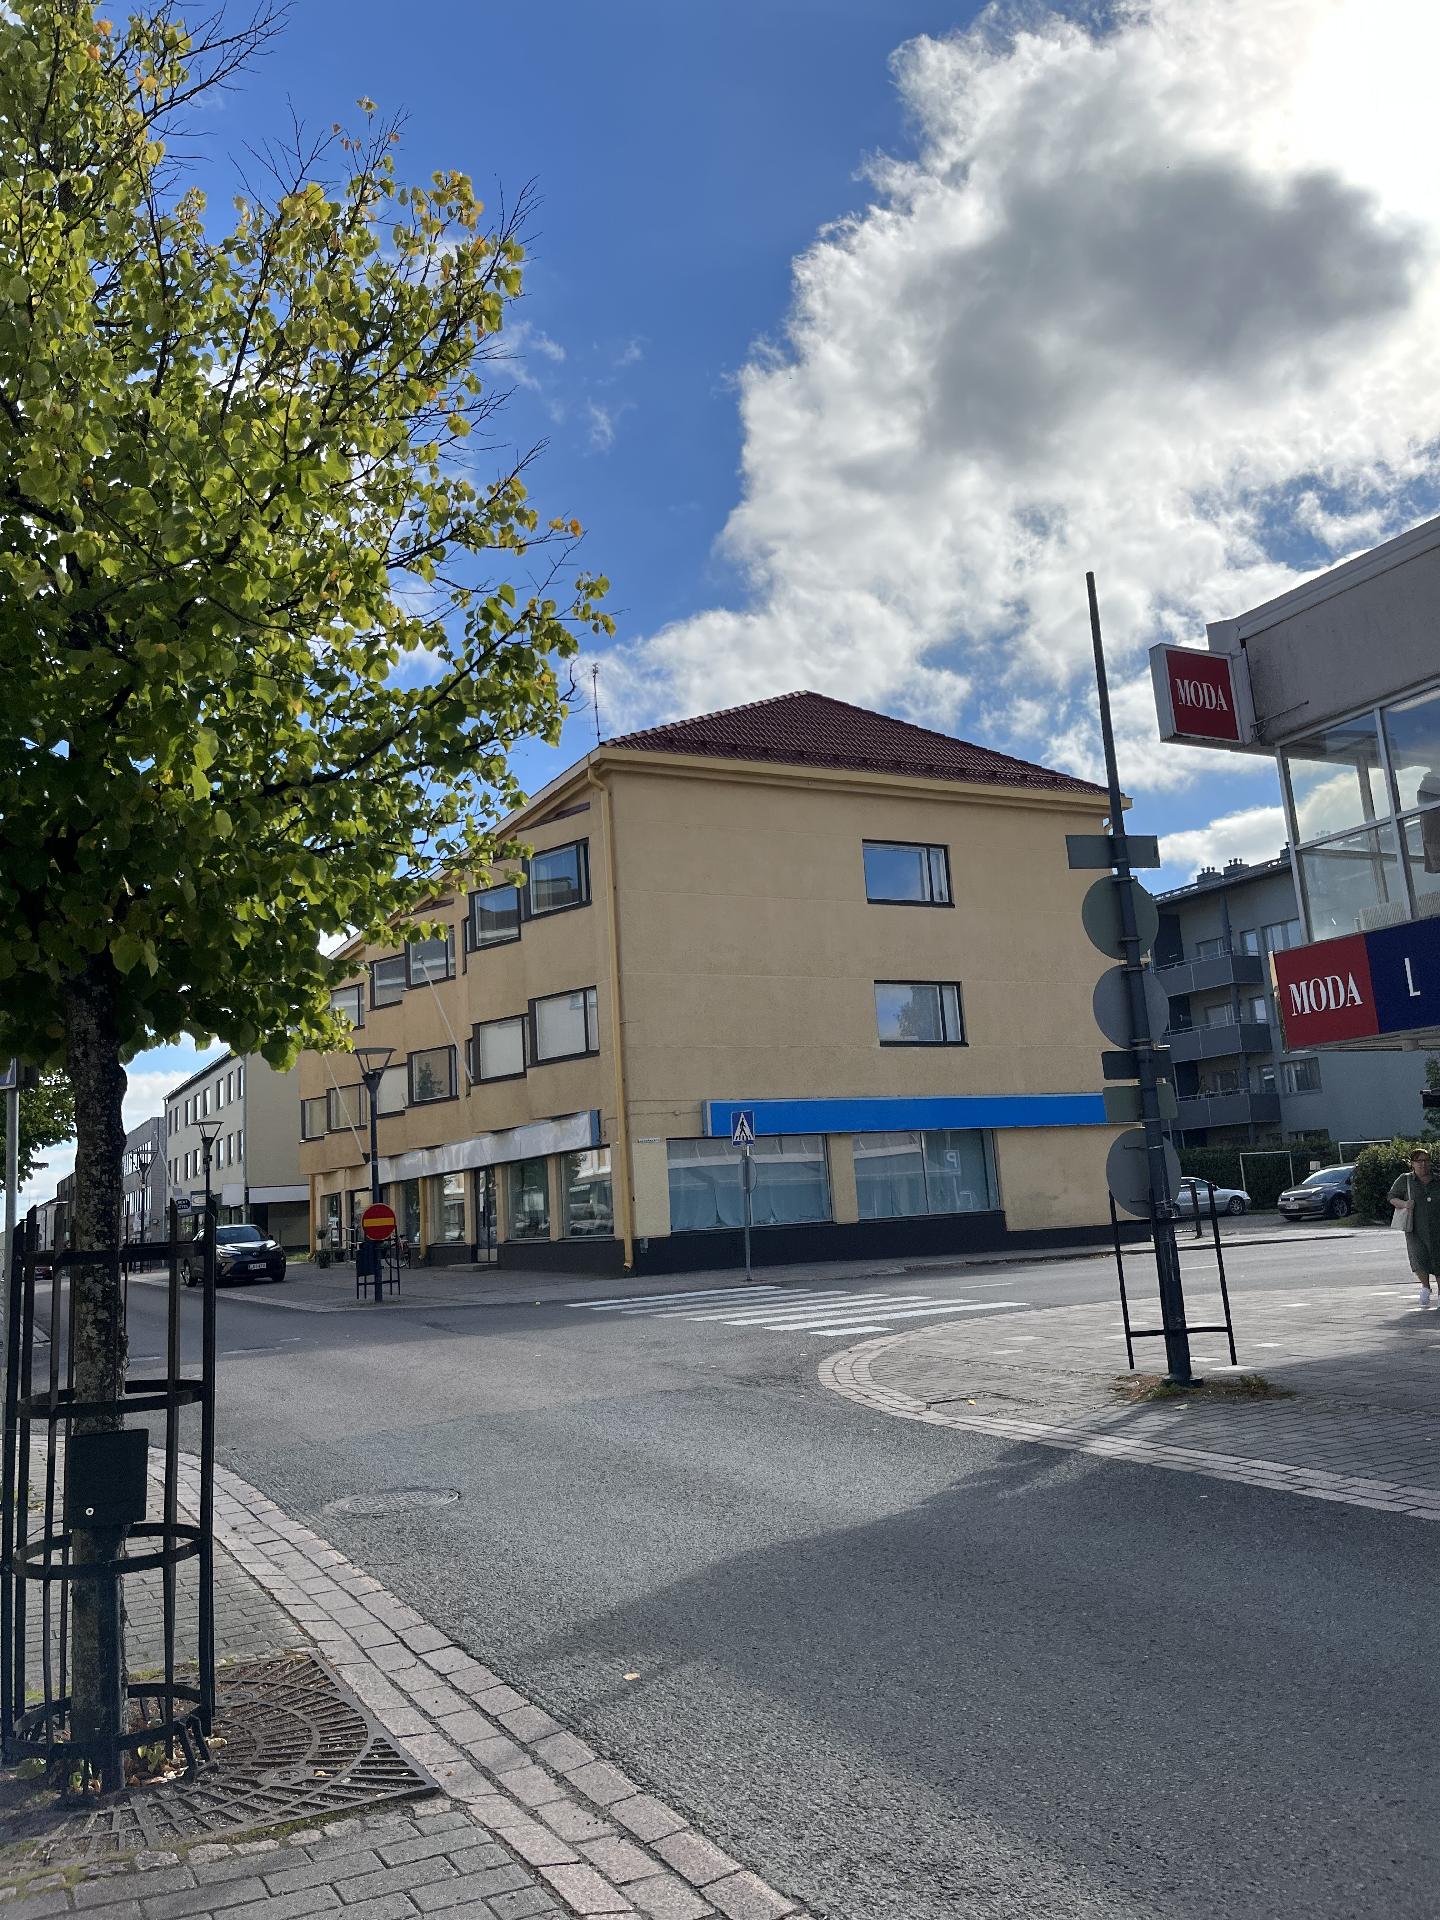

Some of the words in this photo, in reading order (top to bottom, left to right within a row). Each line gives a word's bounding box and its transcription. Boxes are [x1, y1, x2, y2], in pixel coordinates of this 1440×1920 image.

[1175, 678, 1229, 711] MODA
[1288, 971, 1364, 1017] MODA
[1404, 957, 1421, 997] L
